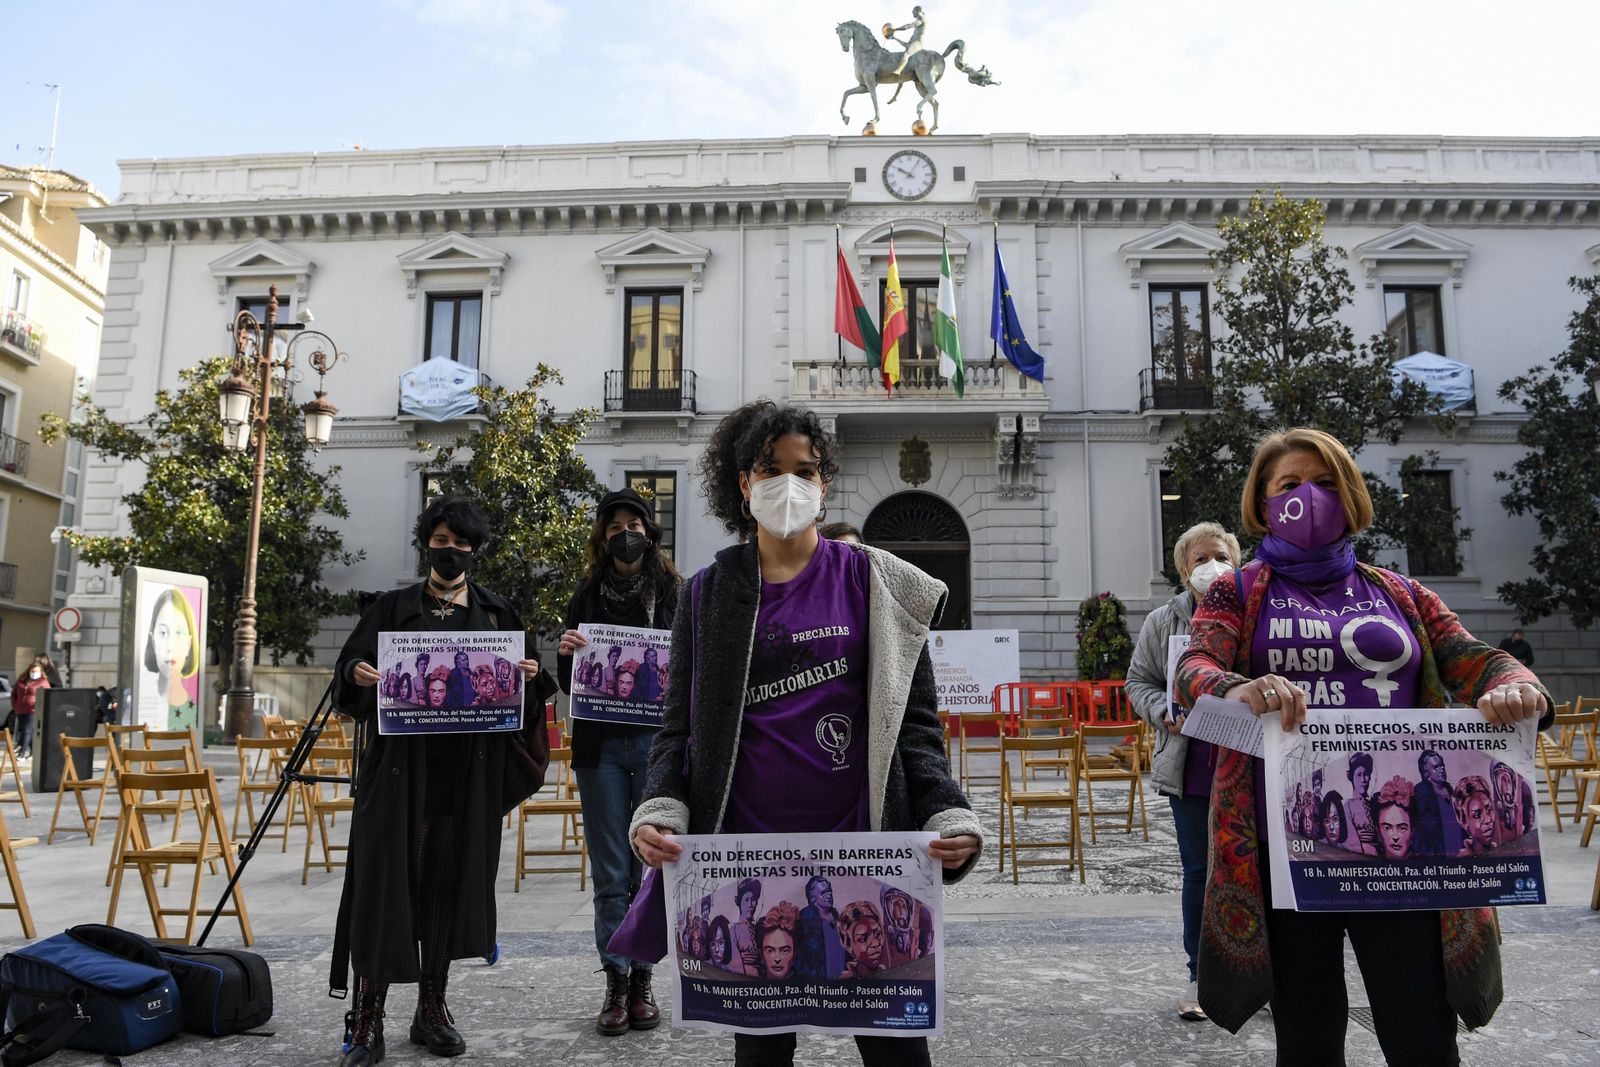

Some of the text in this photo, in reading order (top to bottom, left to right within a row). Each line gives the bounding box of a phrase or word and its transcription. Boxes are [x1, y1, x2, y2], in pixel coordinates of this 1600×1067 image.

[1270, 598, 1388, 617] GRANADA
[606, 630, 646, 640] DERECHOS,
[792, 626, 850, 643] PRECARIAS
[1268, 618, 1333, 640] NI UN
[592, 638, 635, 647] FEMINISTAS
[638, 640, 650, 648] SIN
[1268, 648, 1334, 673] PASO
[949, 683, 979, 693] AÑOS
[1292, 676, 1346, 706] RÁS
[1300, 722, 1516, 736] CON DERECHOS, SIN BARRERAS
[1312, 738, 1507, 752] FEMINISTAS SIN FRONTERAS
[1292, 840, 1314, 852] 8M
[691, 848, 913, 862] CON DERECHOS, SIN BARRERAS
[702, 865, 903, 879] FEMINISTAS SIN FRONTERAS
[1303, 868, 1315, 878] 18
[1316, 868, 1326, 878] h.
[1327, 864, 1403, 877] MANIFESTACIÓN.
[1404, 866, 1421, 876] Pza.
[1423, 865, 1436, 876] del
[1438, 864, 1466, 876] Triunfo
[1473, 864, 1494, 874] Paseo
[1496, 864, 1507, 874] del
[1508, 862, 1529, 873] Salón
[1340, 878, 1501, 892] 20 h. CONCENTRACIÓN. Paseo del Salón
[682, 958, 701, 971] 8M
[693, 983, 701, 992] 18
[703, 985, 710, 994] h.
[712, 984, 783, 996] MANIFESTACIÓN.
[785, 984, 802, 995] Pza.
[804, 984, 817, 994] del
[819, 984, 849, 996] Triunfo
[856, 986, 881, 996] Paseo
[883, 985, 898, 996] del
[899, 985, 923, 996] Salón
[722, 997, 889, 1010] 20 h. CONCENTRACIÓN. Paseo del Salón
